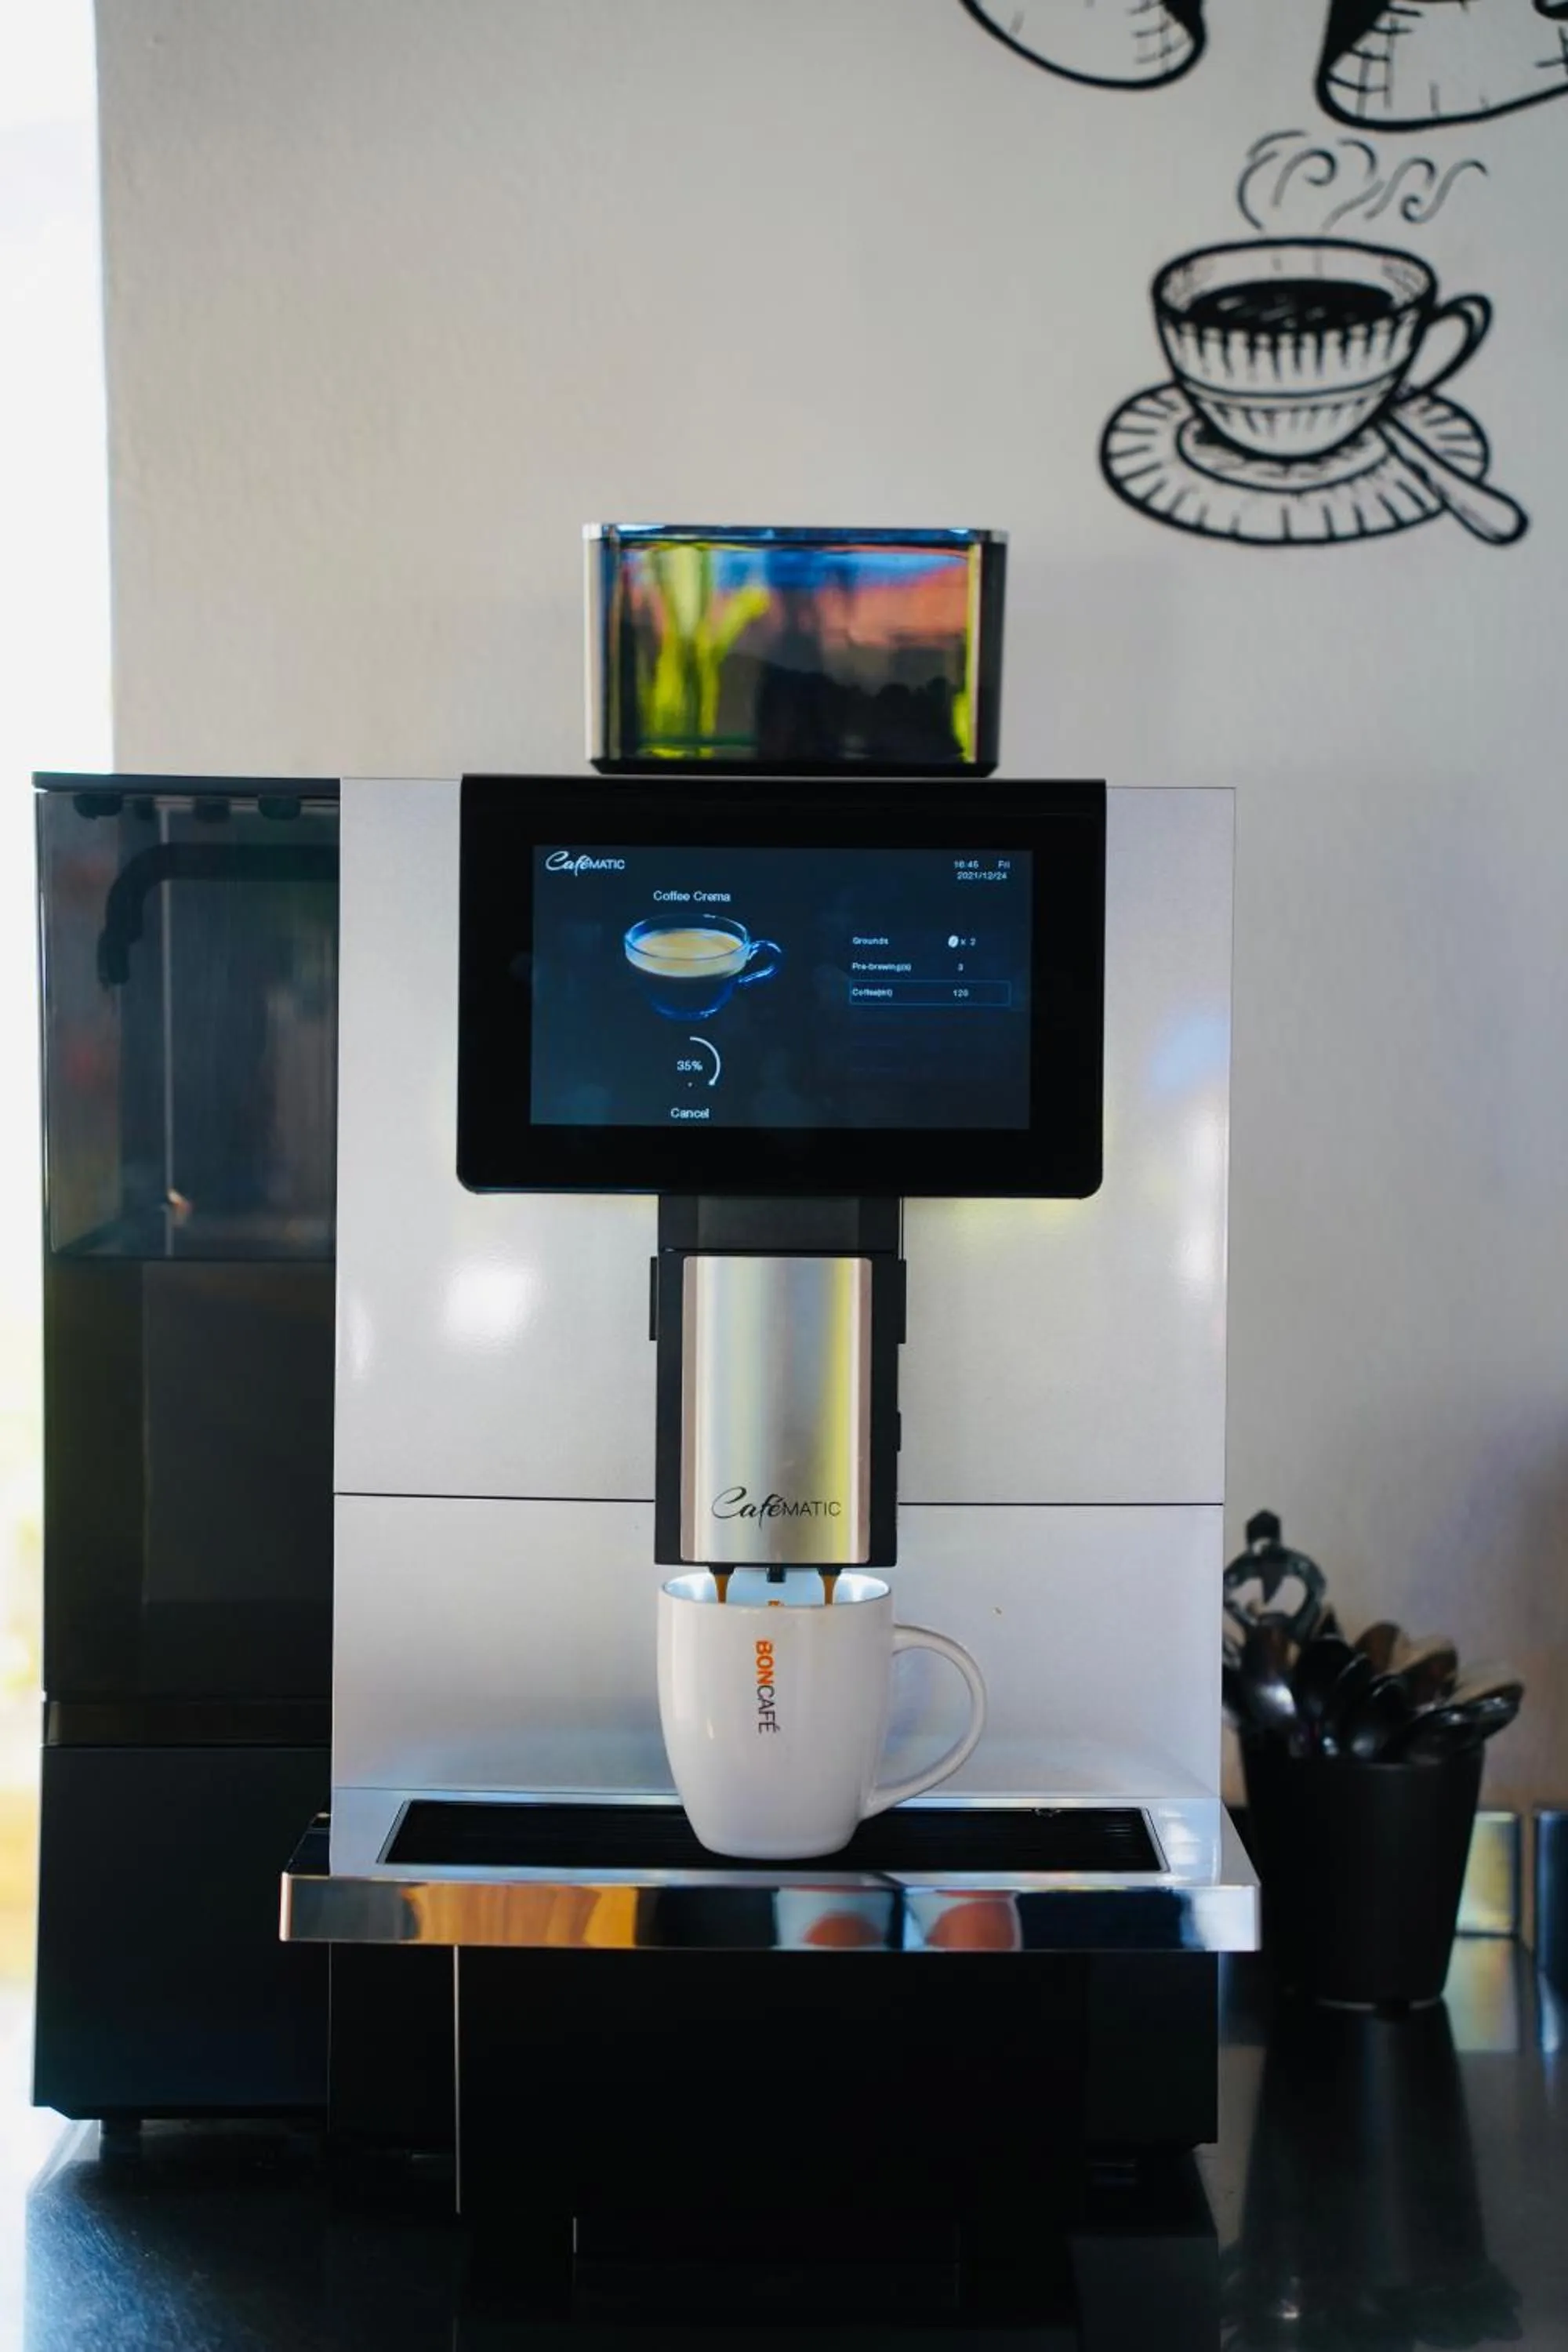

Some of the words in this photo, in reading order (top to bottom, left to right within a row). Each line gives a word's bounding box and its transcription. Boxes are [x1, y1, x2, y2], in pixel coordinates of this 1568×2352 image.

[956, 871, 1008, 880] 2021/12/24
[652, 890, 691, 902] Coffee
[692, 890, 731, 902] Crema
[852, 936, 889, 946] Grounds
[676, 1059, 703, 1072] 35%
[670, 1107, 710, 1120] Cancel
